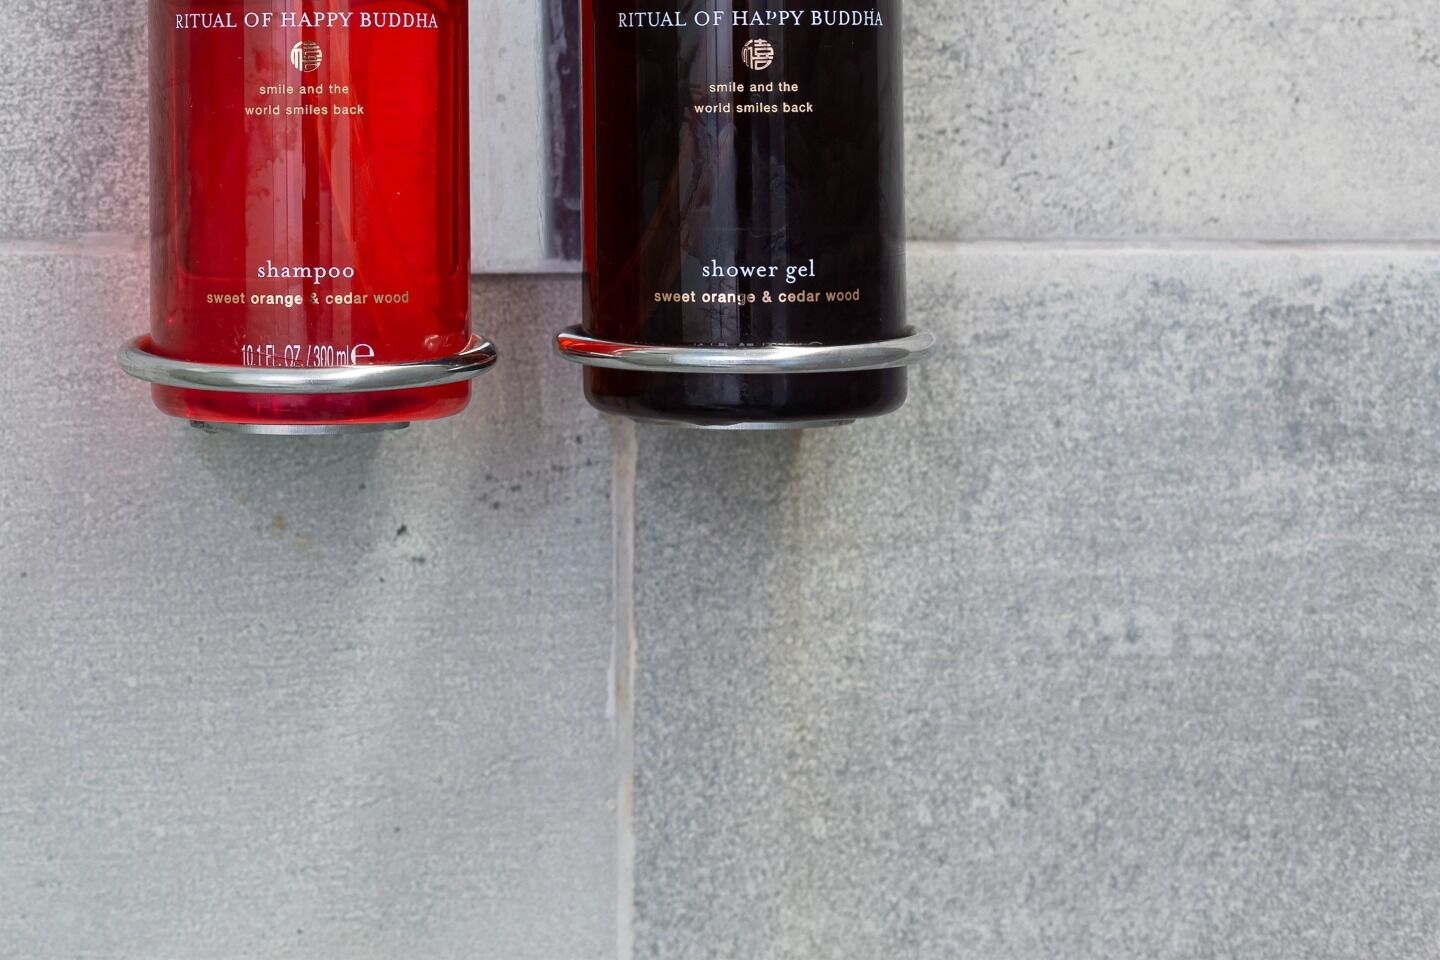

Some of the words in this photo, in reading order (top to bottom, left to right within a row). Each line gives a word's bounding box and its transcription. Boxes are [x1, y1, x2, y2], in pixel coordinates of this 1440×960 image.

[175, 12, 237, 29] RITUAL
[244, 12, 273, 28] OF
[280, 11, 353, 28] HAPPY
[360, 12, 439, 29] BUDDHA
[618, 11, 687, 28] RITUAL
[694, 10, 725, 26] OF
[732, 10, 805, 26] HAPPY
[810, 9, 884, 26] BUDDHA
[259, 84, 294, 94] smile
[299, 84, 323, 94] and
[329, 83, 349, 94] the
[709, 82, 744, 93] smile
[749, 82, 773, 92] and
[778, 81, 799, 92] the
[245, 104, 280, 115] world
[285, 104, 329, 115] smiles
[333, 104, 365, 115] back
[694, 102, 731, 113] world
[736, 102, 778, 113] smiles
[783, 102, 814, 113] back
[257, 260, 355, 285] shampoo
[702, 259, 778, 277] shower
[785, 258, 816, 284] gel
[206, 292, 245, 304] sweet
[250, 293, 304, 307] orange
[310, 292, 320, 305] &
[325, 292, 368, 304] cedar
[373, 291, 409, 304] wood
[654, 291, 696, 302] sweet
[701, 292, 756, 305] orange
[762, 291, 773, 303] &
[778, 290, 821, 303] cedar
[825, 288, 860, 302] wood
[241, 344, 261, 366] 10.1
[313, 344, 334, 367] 300
